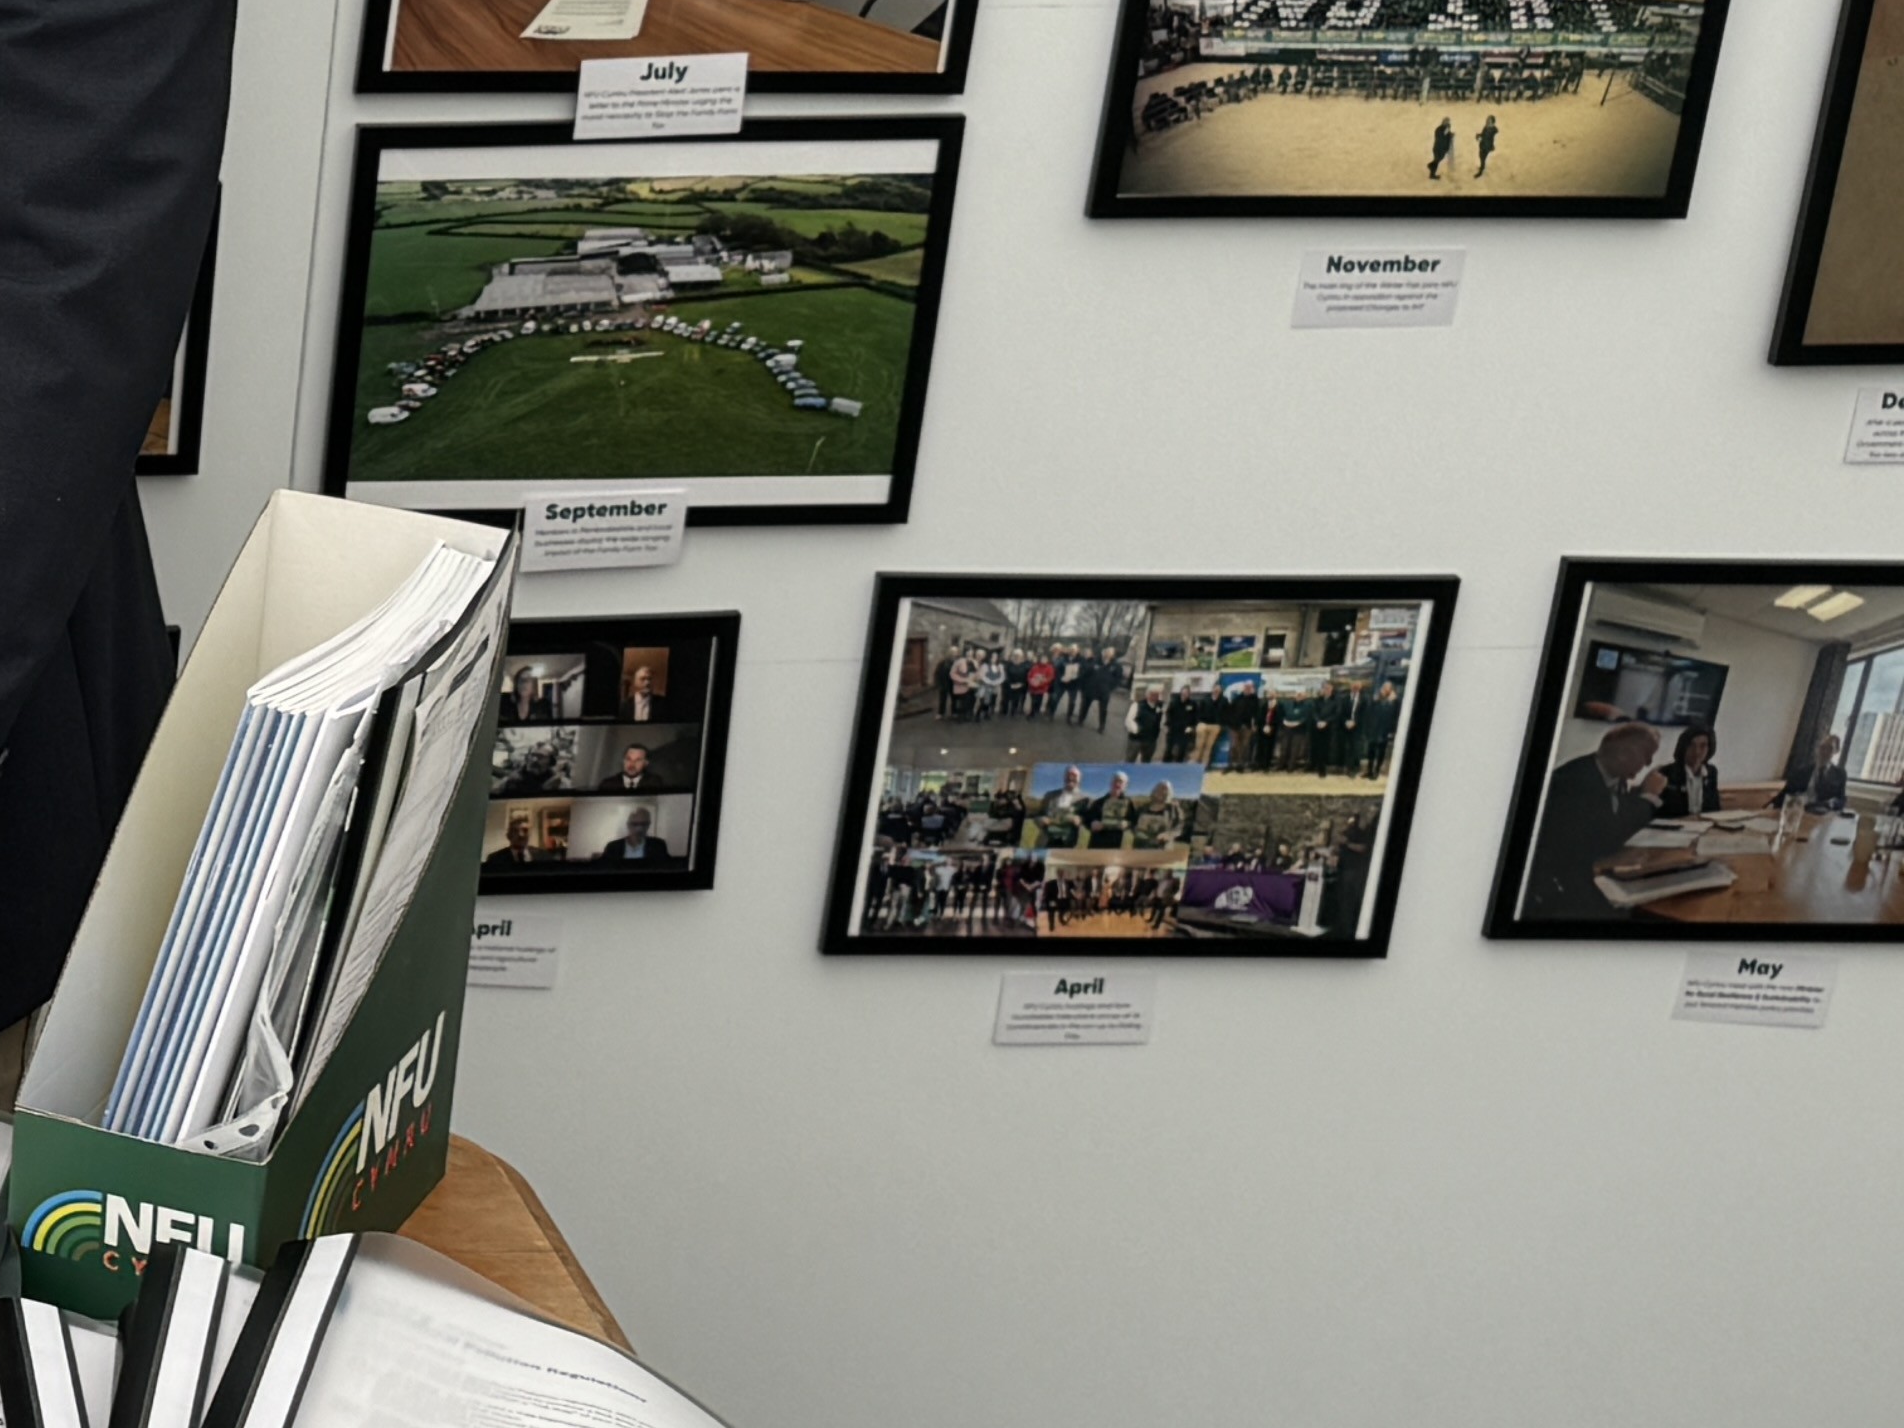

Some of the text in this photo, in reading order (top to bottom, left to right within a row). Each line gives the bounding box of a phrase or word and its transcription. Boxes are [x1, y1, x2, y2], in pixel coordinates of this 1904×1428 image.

[640, 62, 688, 83] July
[1326, 255, 1440, 274] November
[546, 501, 667, 523] September
[470, 920, 512, 939] pril
[1738, 958, 1783, 979] May
[1054, 978, 1104, 998] April
[356, 1011, 447, 1174] NFU
[351, 1105, 432, 1210] CYMRU
